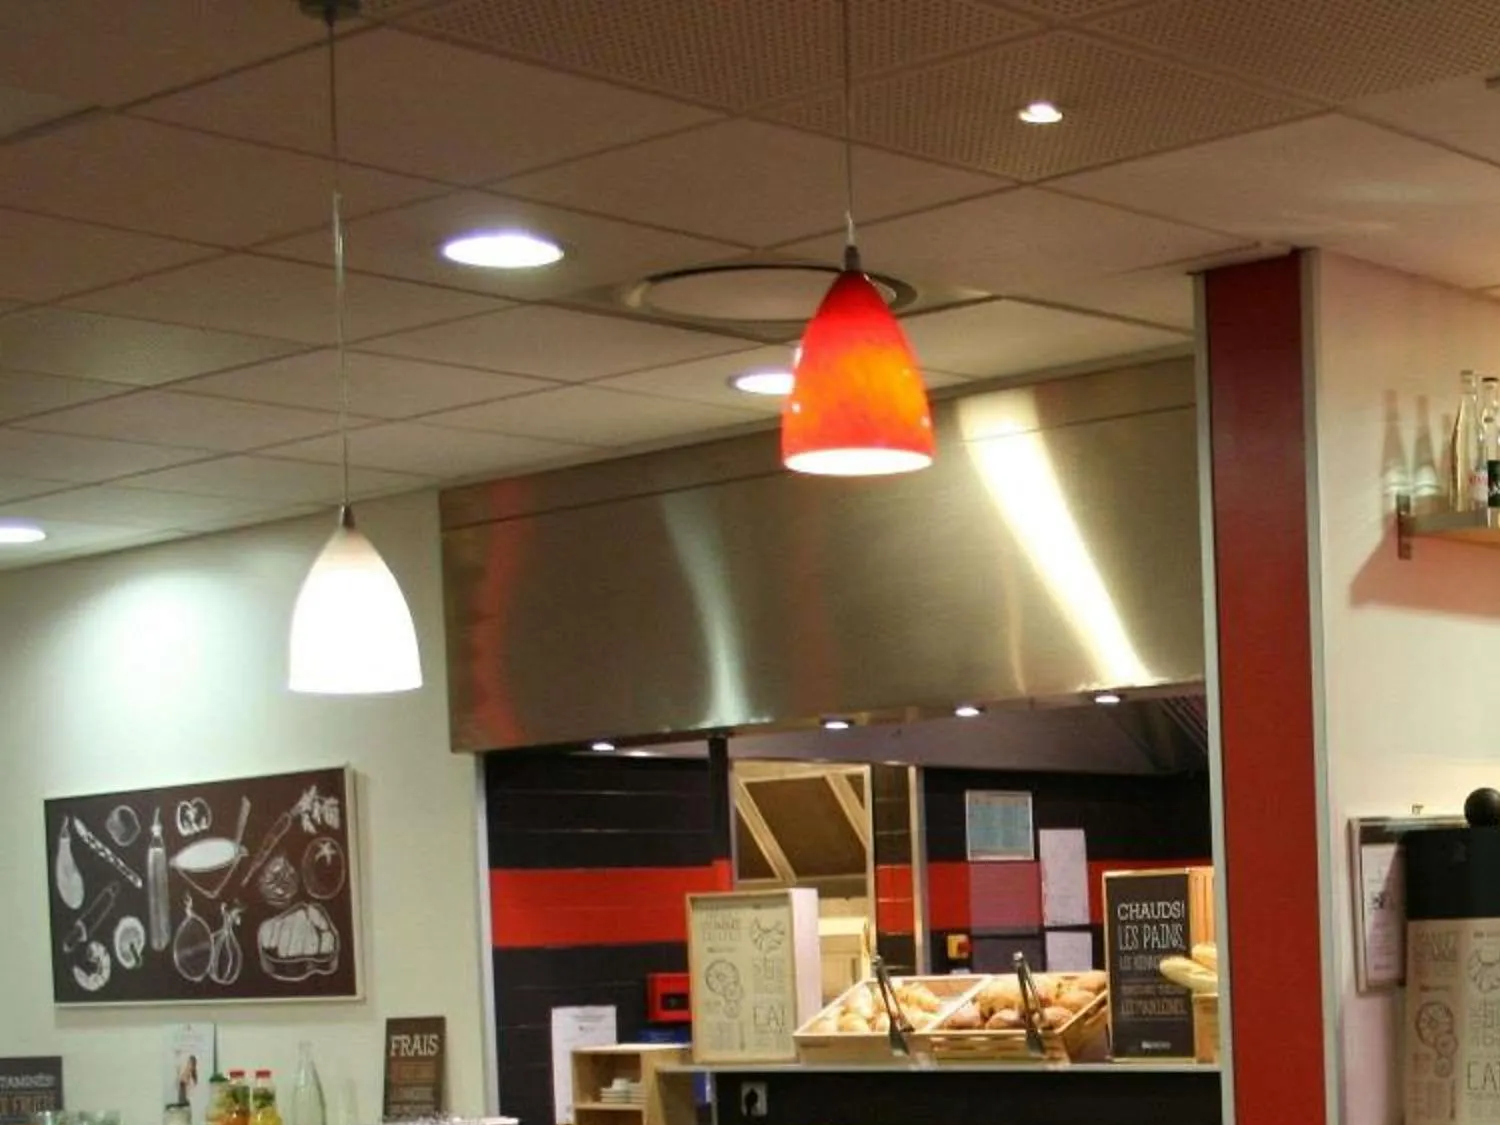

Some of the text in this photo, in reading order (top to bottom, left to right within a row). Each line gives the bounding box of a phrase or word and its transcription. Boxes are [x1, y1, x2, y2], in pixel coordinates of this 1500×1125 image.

[1117, 901, 1185, 920] CHAUDS!
[1118, 923, 1139, 950] LES
[391, 1033, 439, 1057] FRAIS
